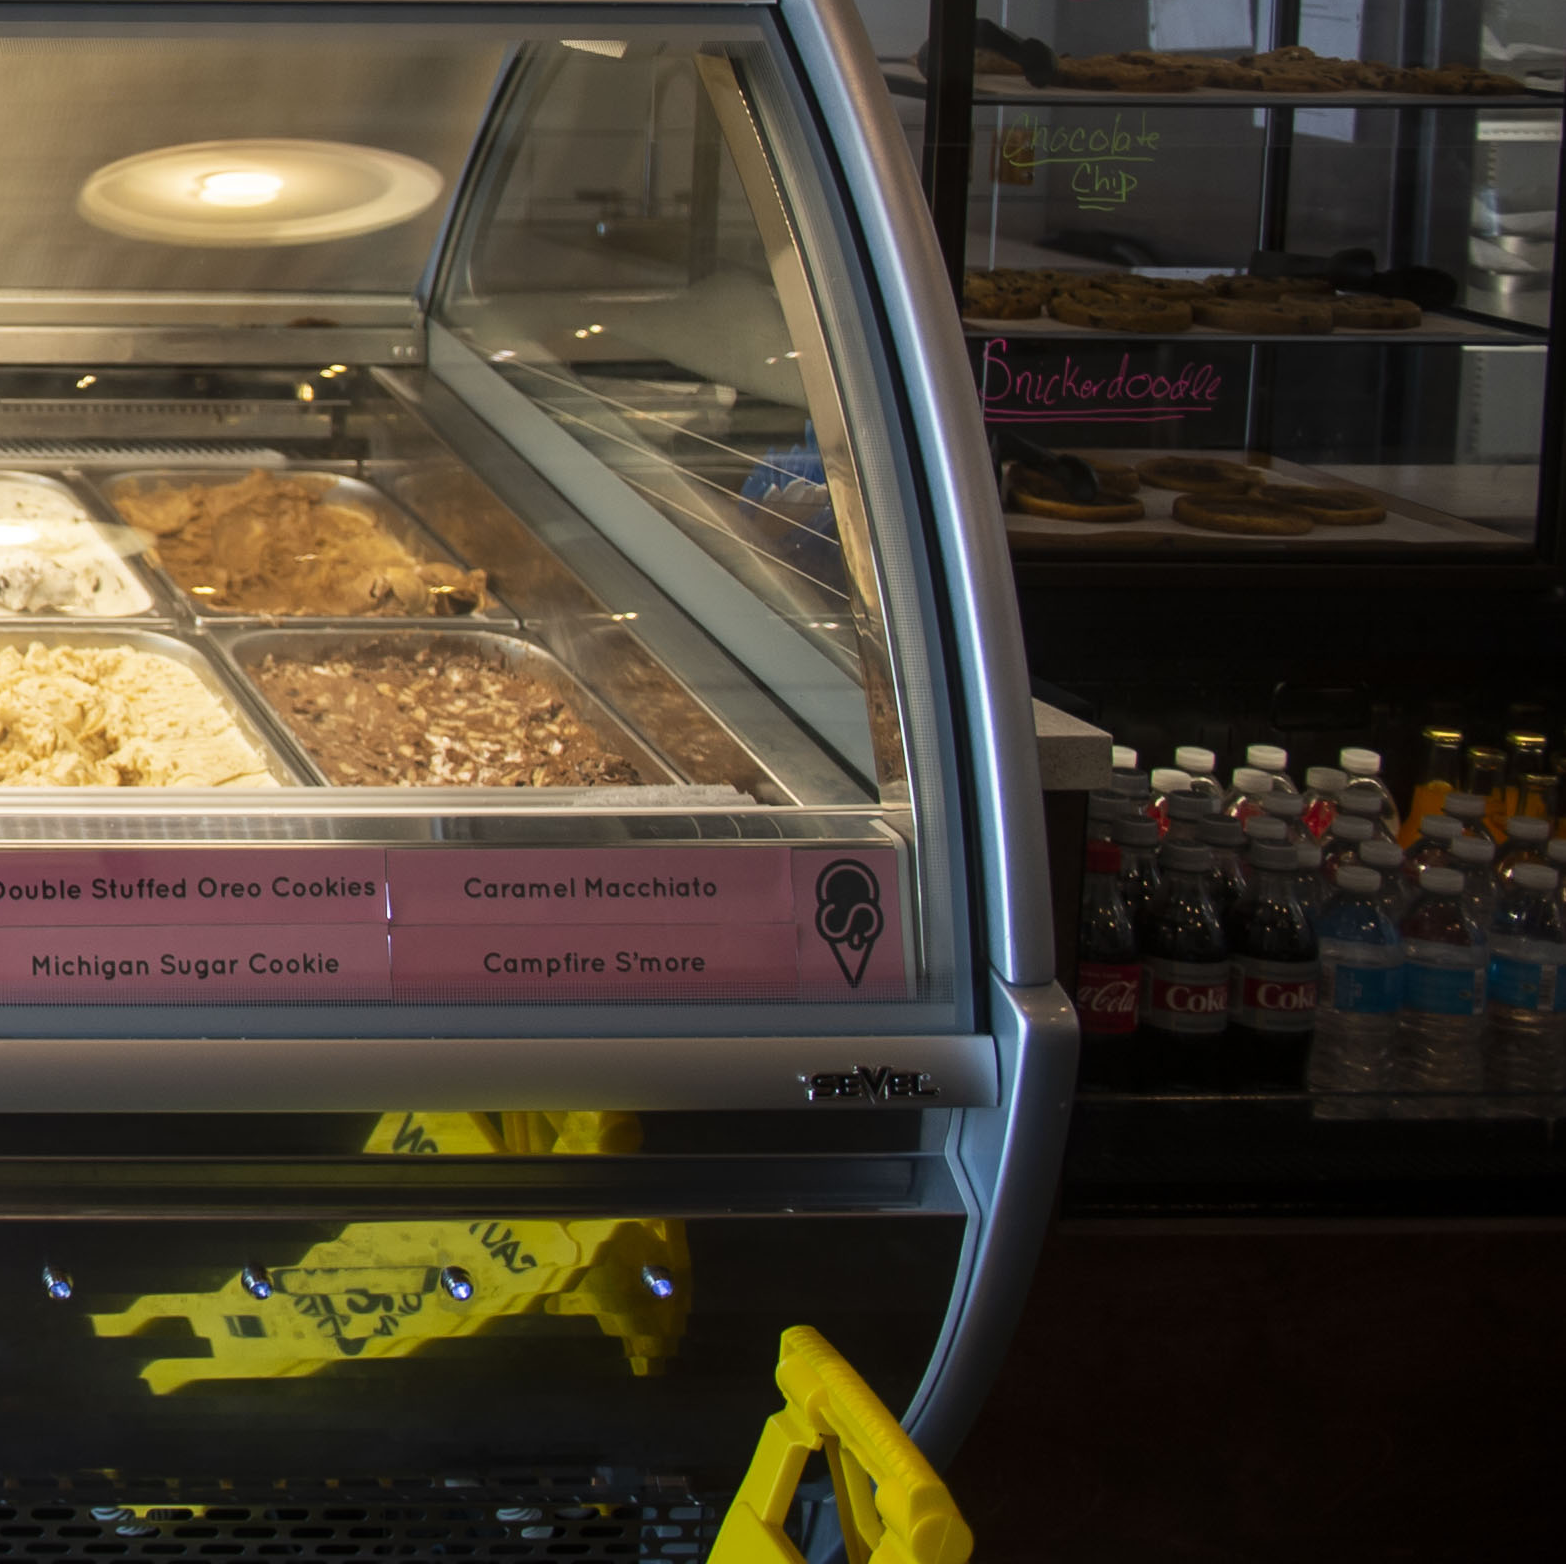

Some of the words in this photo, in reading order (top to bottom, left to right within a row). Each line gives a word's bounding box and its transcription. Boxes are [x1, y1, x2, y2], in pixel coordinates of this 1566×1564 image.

[1002, 112, 1161, 160] Chocolate
[1072, 163, 1138, 203] Chip
[980, 339, 1222, 405] Snickerdoodle
[92, 878, 186, 899] Stuffed
[198, 877, 261, 898] Oreo
[272, 876, 375, 897] Cookies
[464, 878, 575, 898] Caramel
[585, 877, 716, 898] Macchiato
[32, 955, 149, 980] Michigan
[161, 954, 238, 979] Sugar
[249, 953, 339, 975] Cookie
[483, 952, 605, 978] Campfire
[616, 951, 705, 973] S’more
[810, 1066, 939, 1101] SEVEL
